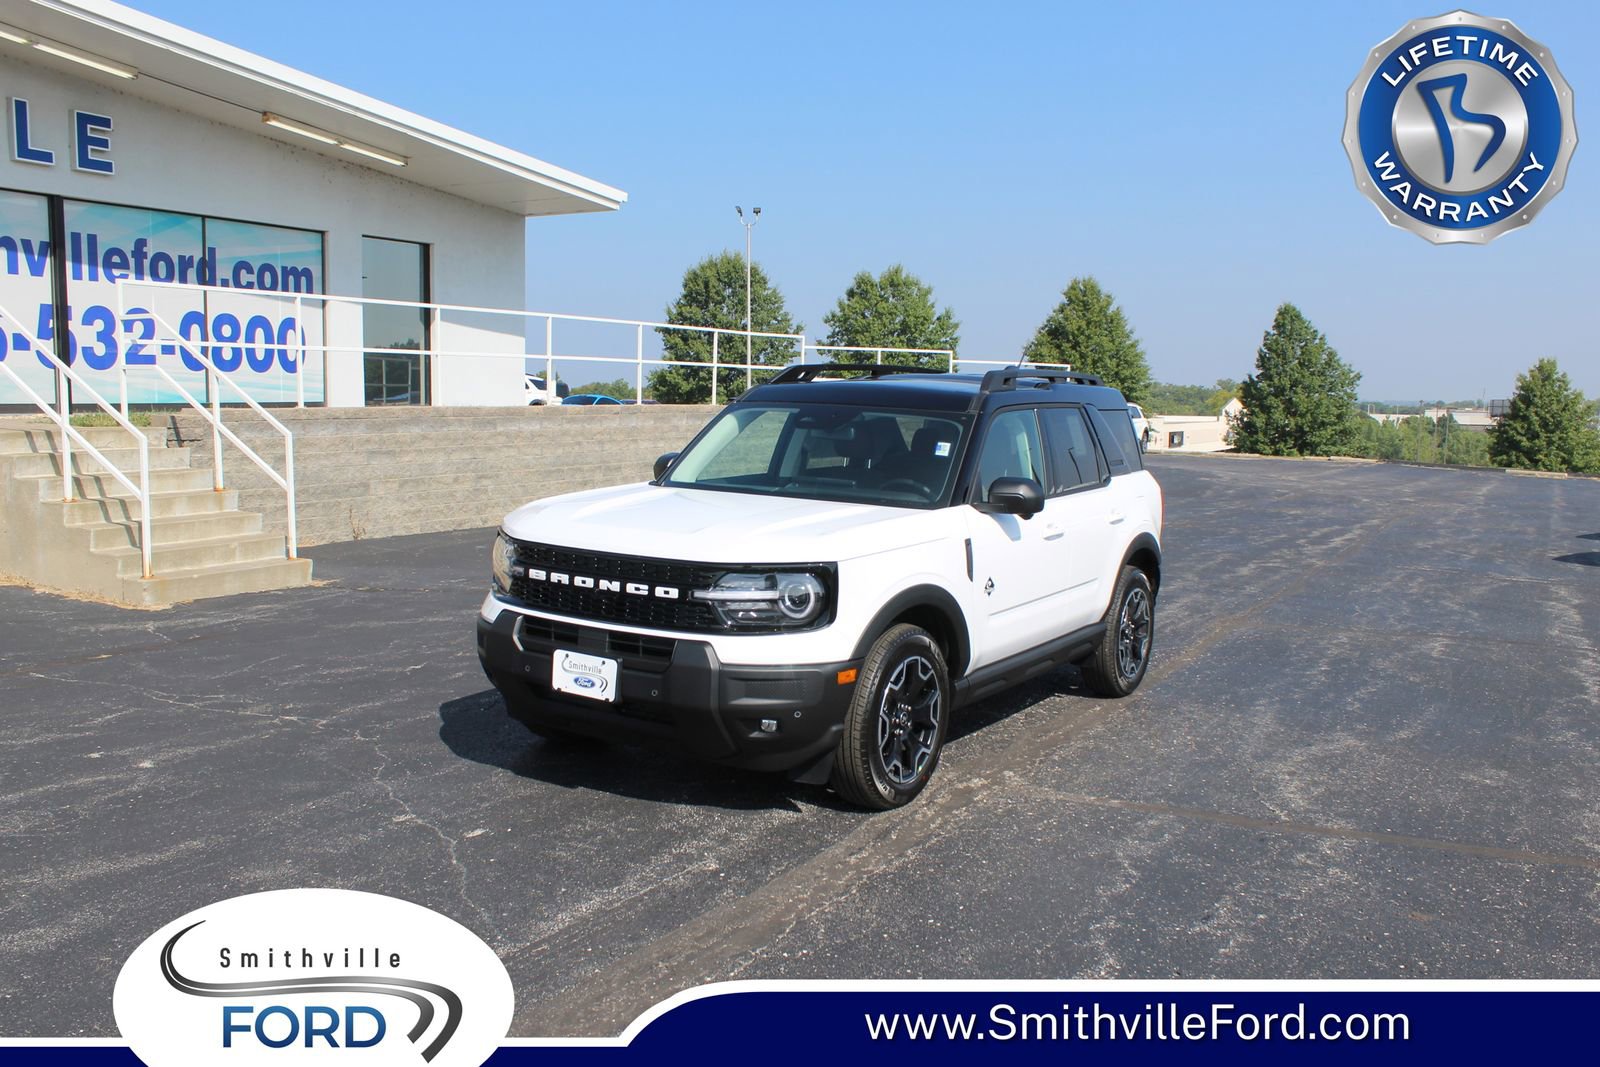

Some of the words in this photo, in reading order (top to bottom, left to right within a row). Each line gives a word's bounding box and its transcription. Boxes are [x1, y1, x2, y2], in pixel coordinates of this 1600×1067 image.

[0, 303, 306, 374] -532-0800
[528, 568, 679, 599] BRONCO
[568, 660, 603, 675] Smithville
